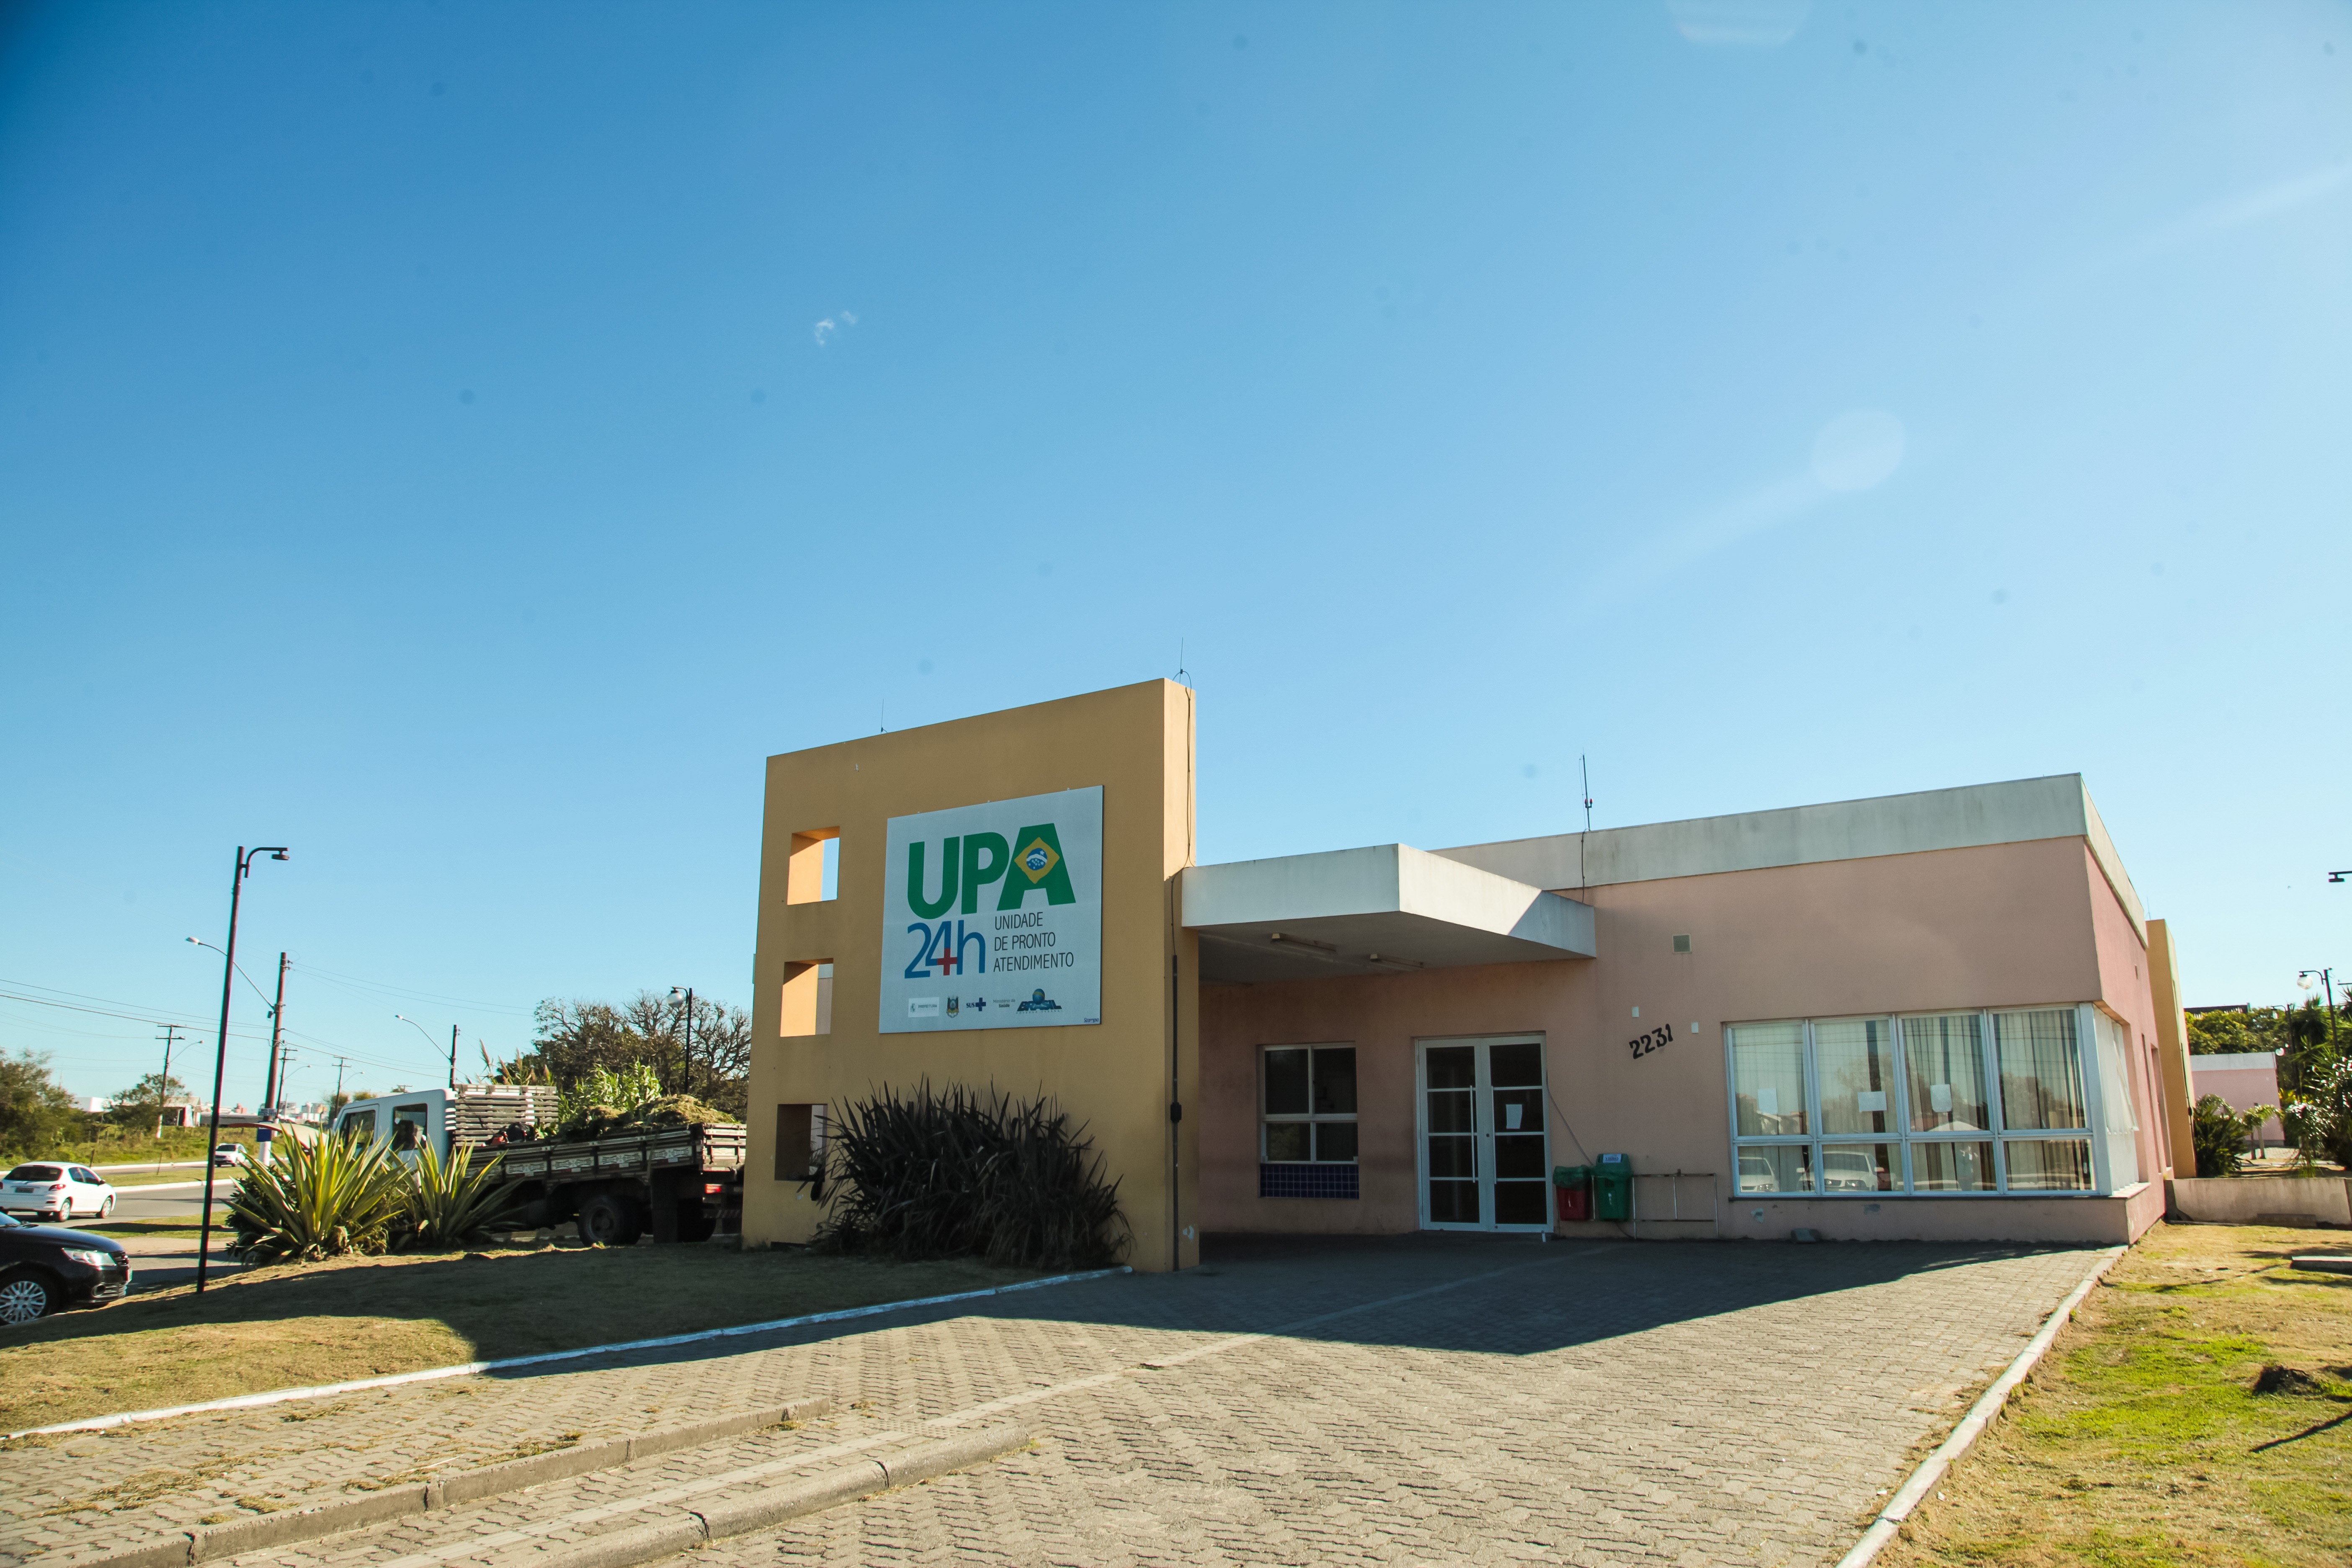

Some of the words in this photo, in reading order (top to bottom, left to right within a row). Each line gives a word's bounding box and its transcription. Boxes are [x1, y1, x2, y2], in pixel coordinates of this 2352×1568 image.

[908, 823, 1076, 919] UPA
[995, 912, 1043, 930] UNIDADE
[905, 920, 986, 979] 24h
[994, 936, 1008, 951] DE
[1012, 932, 1056, 949] PRONTO
[993, 952, 1074, 972] ATENDIMENTO
[1017, 1000, 1062, 1011] BRASIL
[1629, 1024, 1673, 1060] 2231
